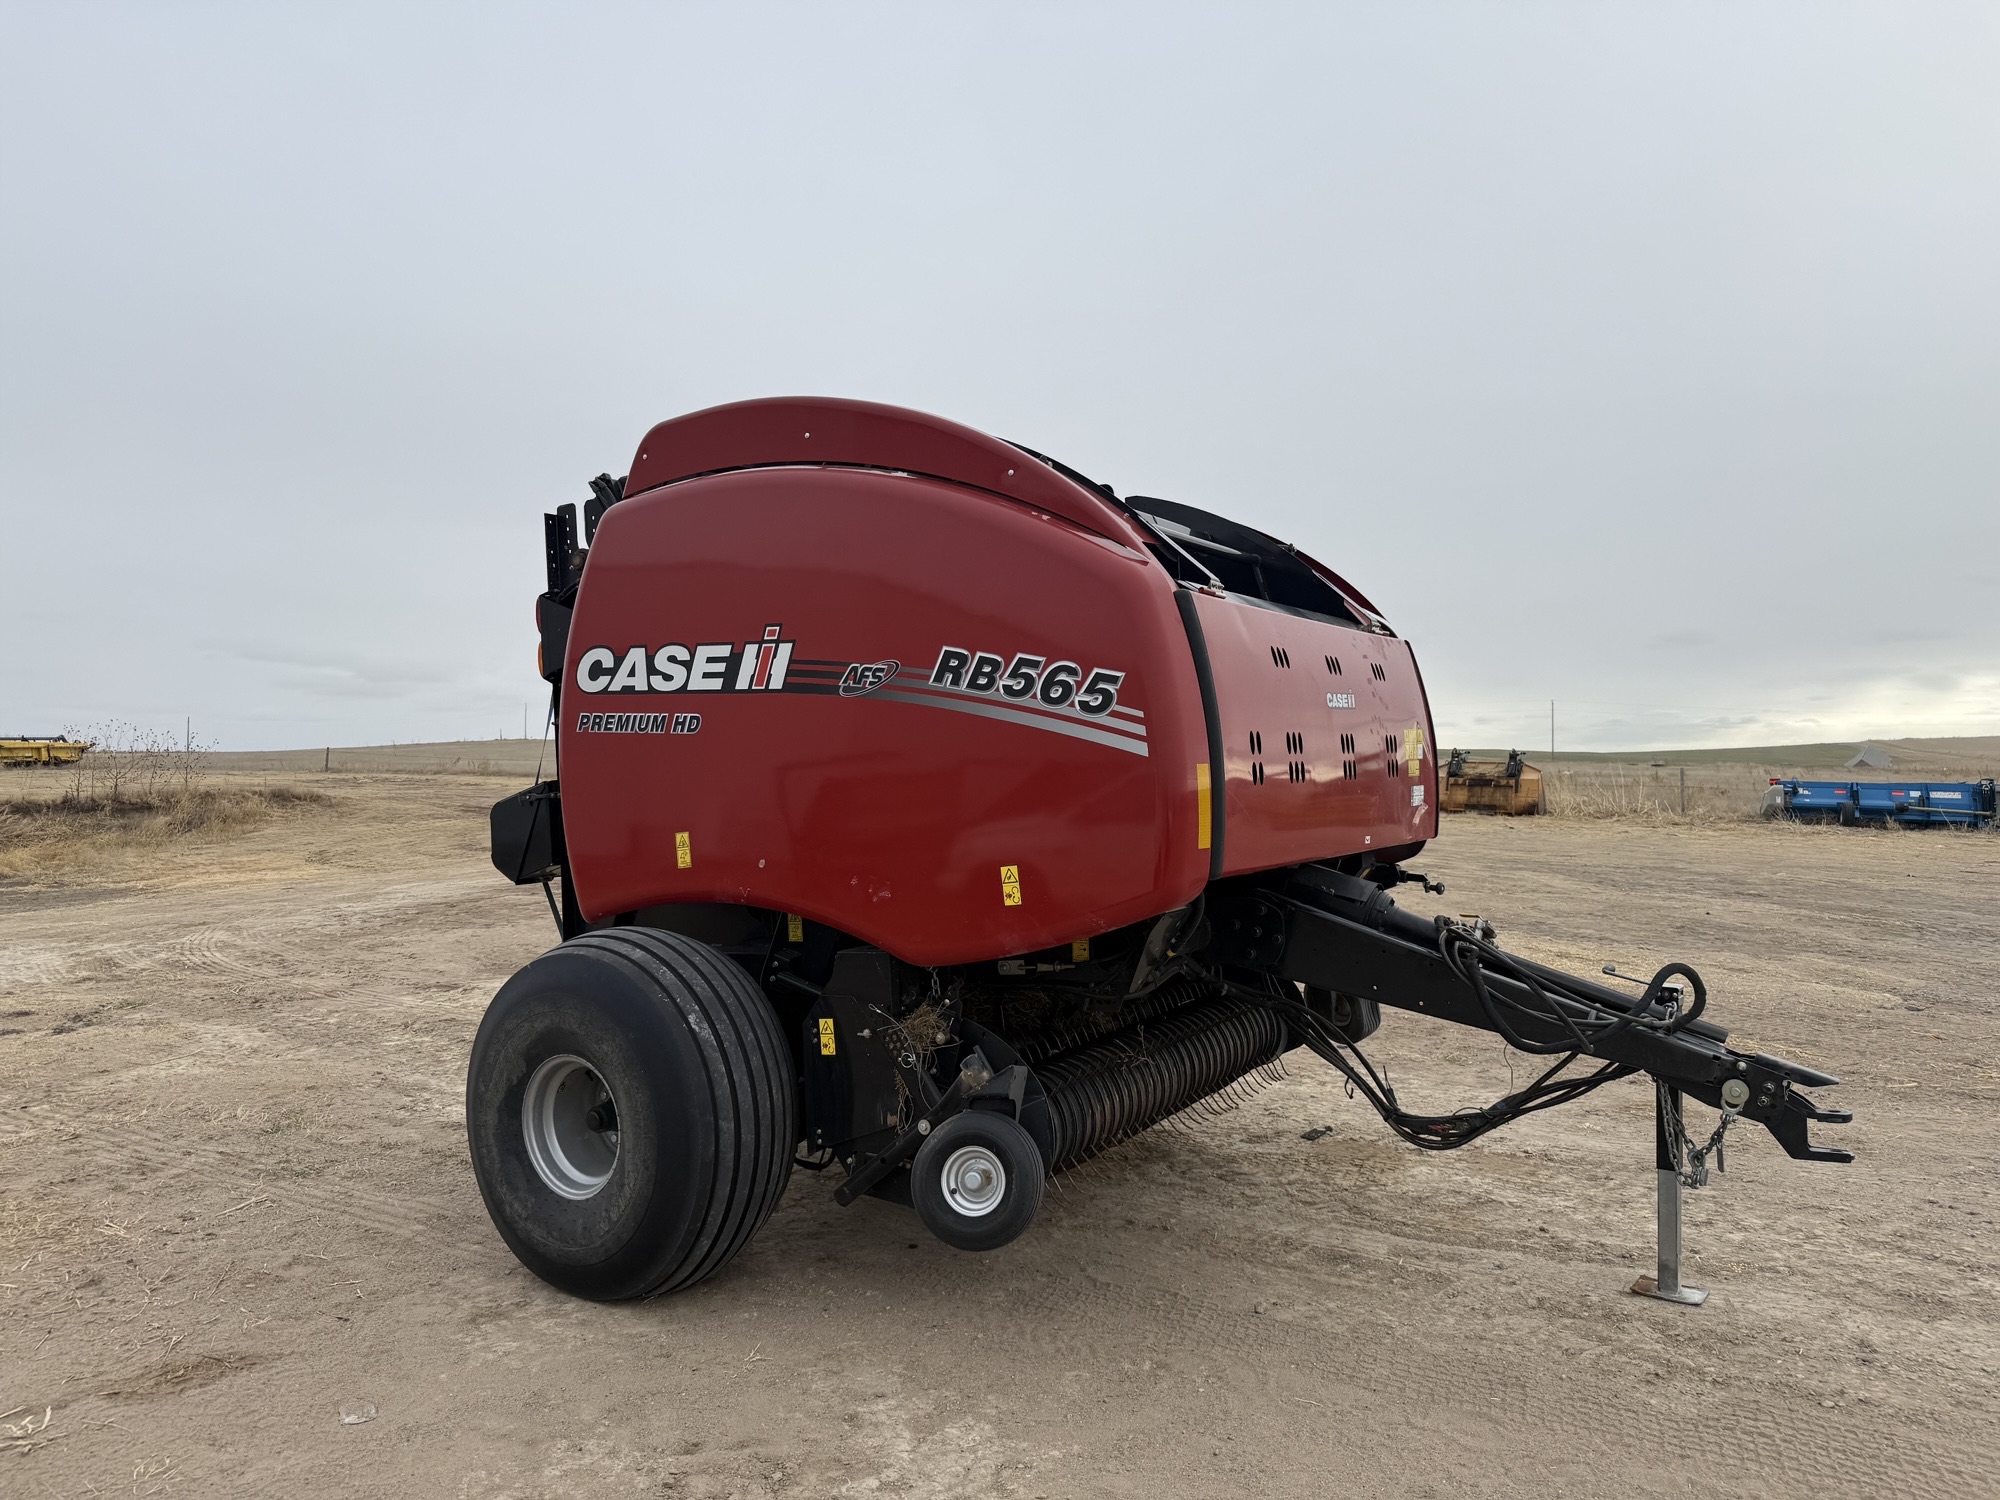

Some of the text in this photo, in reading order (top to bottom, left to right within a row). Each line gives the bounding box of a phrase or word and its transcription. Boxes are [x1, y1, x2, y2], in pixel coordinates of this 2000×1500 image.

[577, 644, 732, 693] CASE
[839, 663, 888, 688] AFS
[929, 645, 1126, 717] RB565
[1326, 692, 1348, 708] CASE
[577, 713, 701, 734] PREMIUM HD
